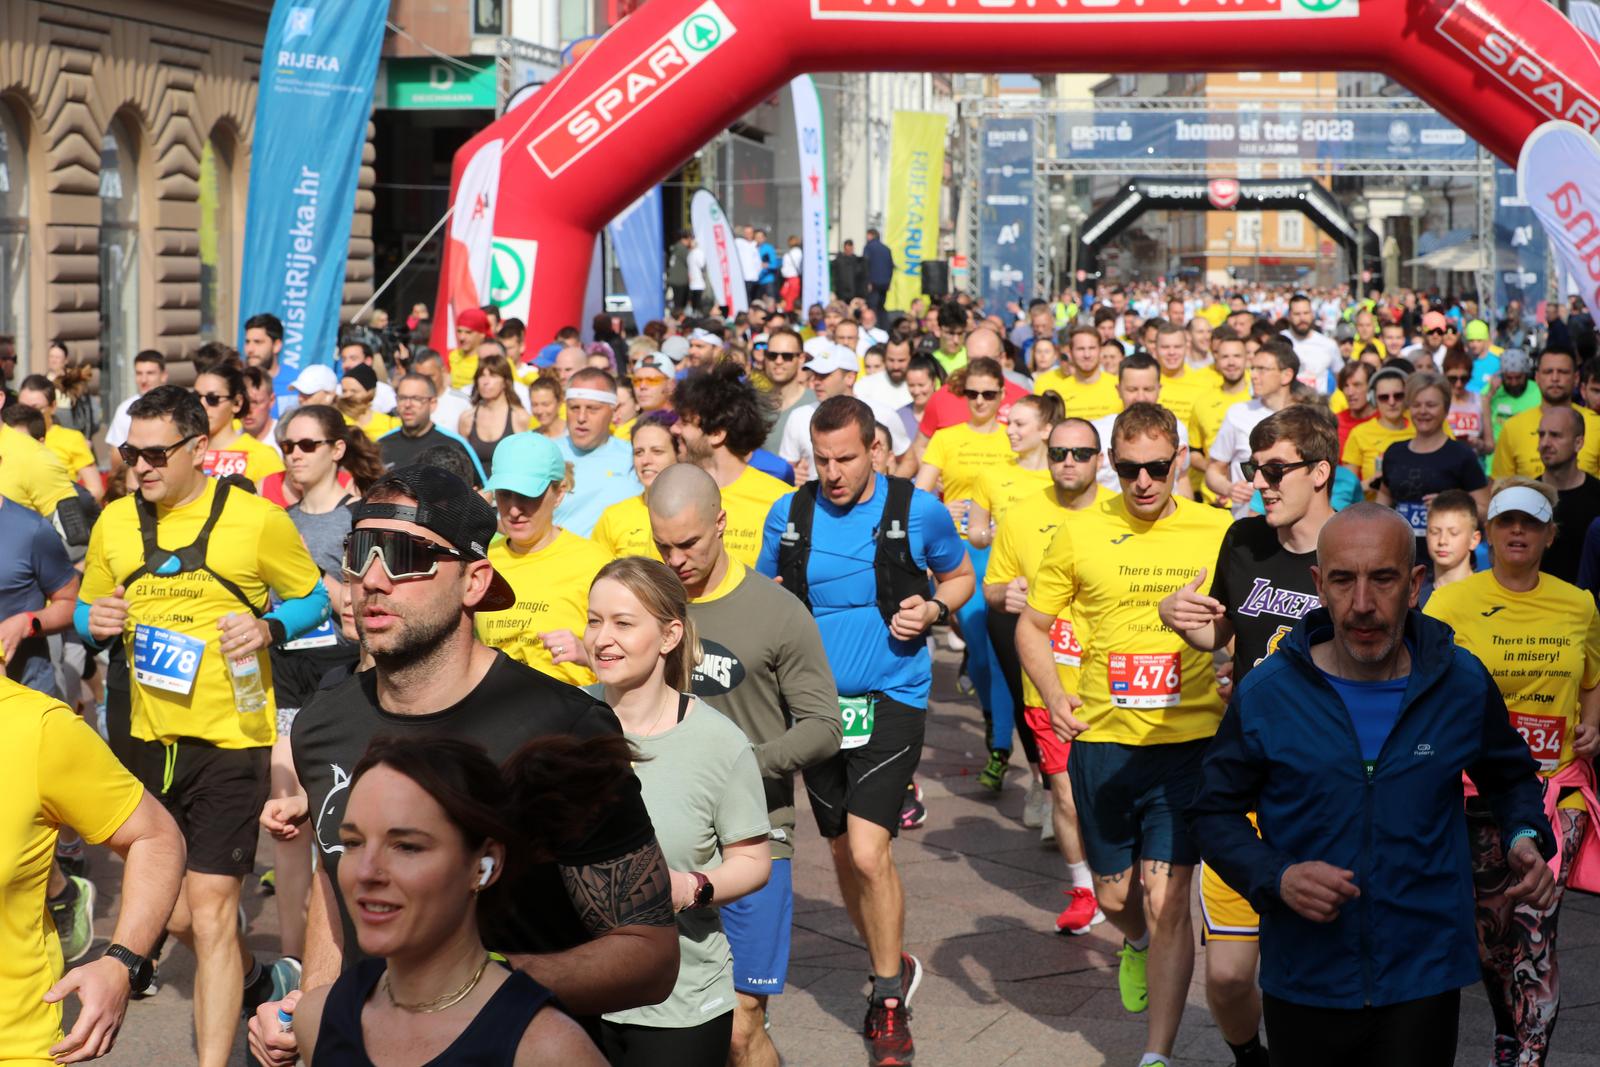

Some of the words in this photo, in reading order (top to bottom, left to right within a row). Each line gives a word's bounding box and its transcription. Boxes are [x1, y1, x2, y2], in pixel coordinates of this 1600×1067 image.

[277, 51, 340, 73] RIJEKA
[429, 65, 456, 90] D
[1478, 33, 1600, 131] SPAR
[567, 45, 684, 144] SPAR
[1071, 126, 1115, 141] ERSTE
[1176, 119, 1235, 141] homo
[1238, 119, 1259, 141] si
[1301, 119, 1355, 141] 2023
[1147, 185, 1203, 199] SPORT
[1241, 185, 1299, 199] VISION
[904, 150, 929, 276] RIJEKARUN
[215, 457, 247, 477] 469
[1118, 564, 1150, 576] There
[1153, 565, 1163, 576] is
[1166, 566, 1200, 579] magic
[136, 585, 147, 596] 21
[150, 585, 166, 595] km
[169, 586, 204, 599] today!
[1129, 582, 1140, 593] in
[516, 600, 550, 614] magic
[1136, 599, 1151, 607] ask
[486, 617, 494, 629] in
[496, 616, 533, 631] misery!
[1492, 635, 1523, 645] There
[1526, 635, 1536, 645] is
[1539, 635, 1571, 648] magic
[151, 641, 198, 674] 778
[1503, 650, 1514, 661] in
[1517, 650, 1560, 663] misery!
[1133, 664, 1179, 690] 476
[1492, 669, 1509, 678] Just
[1511, 669, 1526, 677] ask
[1528, 669, 1543, 679] any
